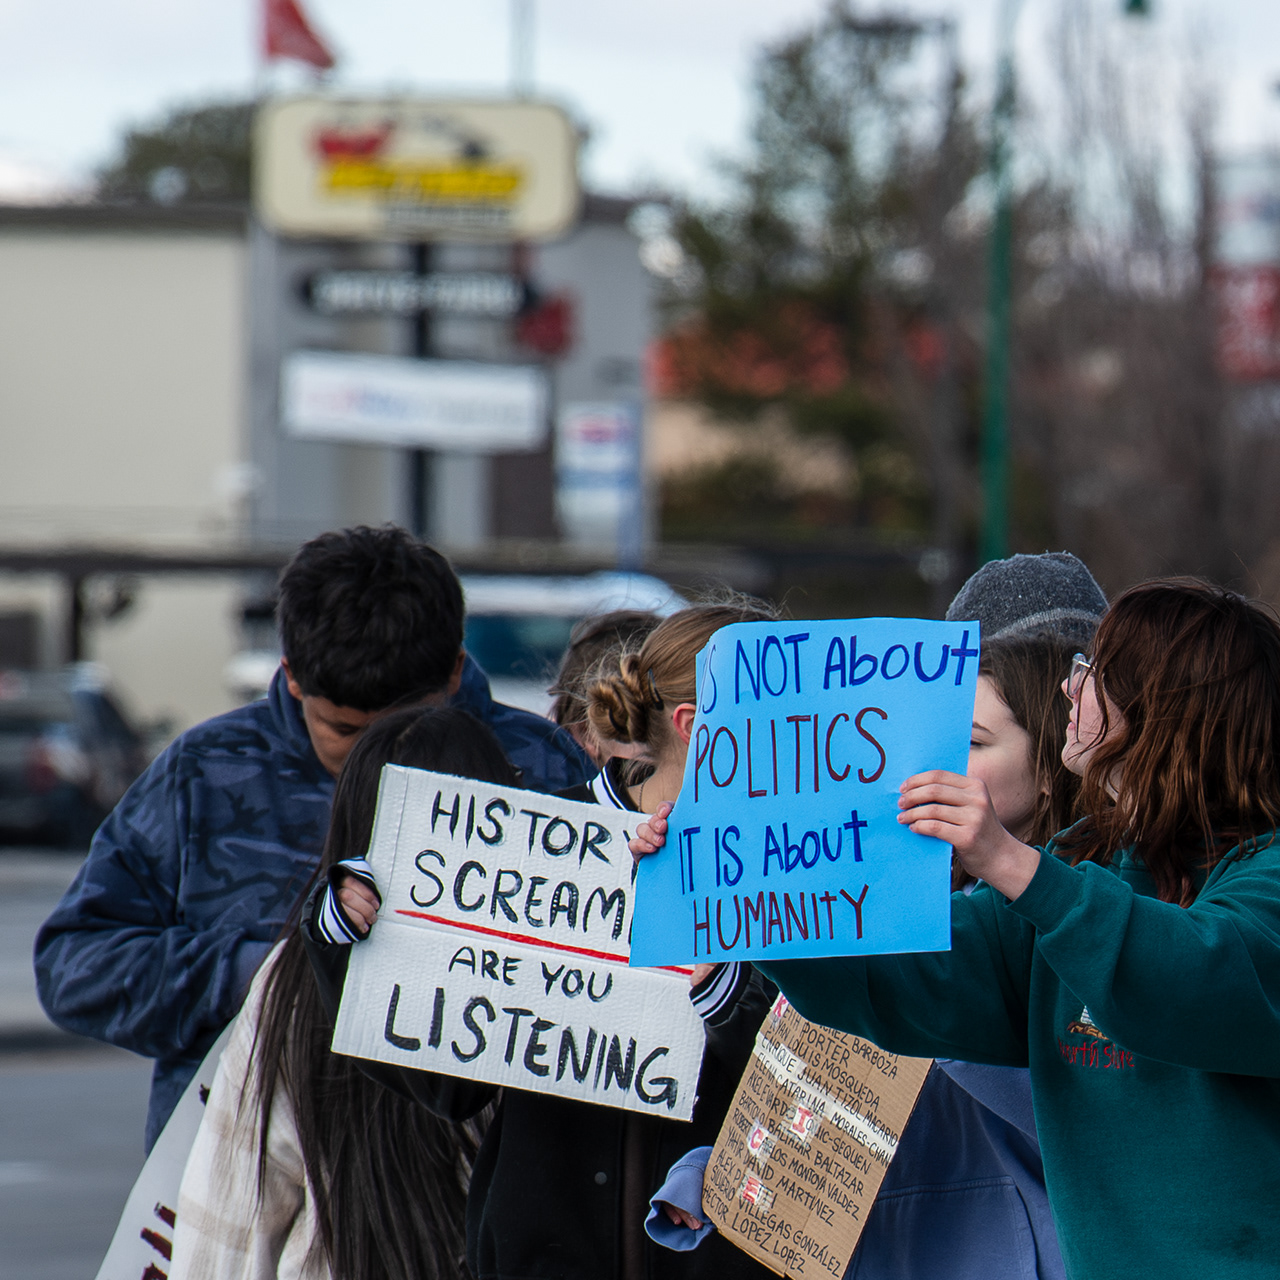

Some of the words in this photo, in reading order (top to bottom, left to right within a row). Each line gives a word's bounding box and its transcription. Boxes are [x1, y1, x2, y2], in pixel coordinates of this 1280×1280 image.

[735, 633, 810, 704] NOT
[694, 706, 888, 803] POLITICS
[678, 826, 701, 896] IT
[714, 825, 744, 887] IS
[410, 850, 632, 945] SCREAM
[693, 884, 870, 957] HUMANITY
[448, 945, 523, 986] ARE
[540, 961, 613, 1002] YOU
[384, 983, 679, 1110] LISTENING
[788, 1033, 821, 1067] LOUIS
[821, 1059, 881, 1112] MOSQUEDA
[801, 1021, 850, 1068] PORTER
[852, 1038, 898, 1079] BARBOZA
[797, 1066, 833, 1096] JUAN
[862, 1110, 898, 1147] MACARIO
[830, 1112, 892, 1168] MORALES-CHAN
[716, 1149, 736, 1176] ALEX
[743, 1152, 774, 1180] DAVID
[776, 1176, 835, 1227] MARTINEZ
[788, 1158, 827, 1193] MONTOYA
[827, 1183, 860, 1221] VALDEZ
[813, 1150, 863, 1197] BALTAZAR
[703, 1183, 729, 1223] HECTOR
[731, 1212, 773, 1252] LOPEZ
[773, 1240, 806, 1274] LOPEZ
[738, 1198, 792, 1239] VILLEGAS
[792, 1230, 841, 1278] GONZÁLEZ
